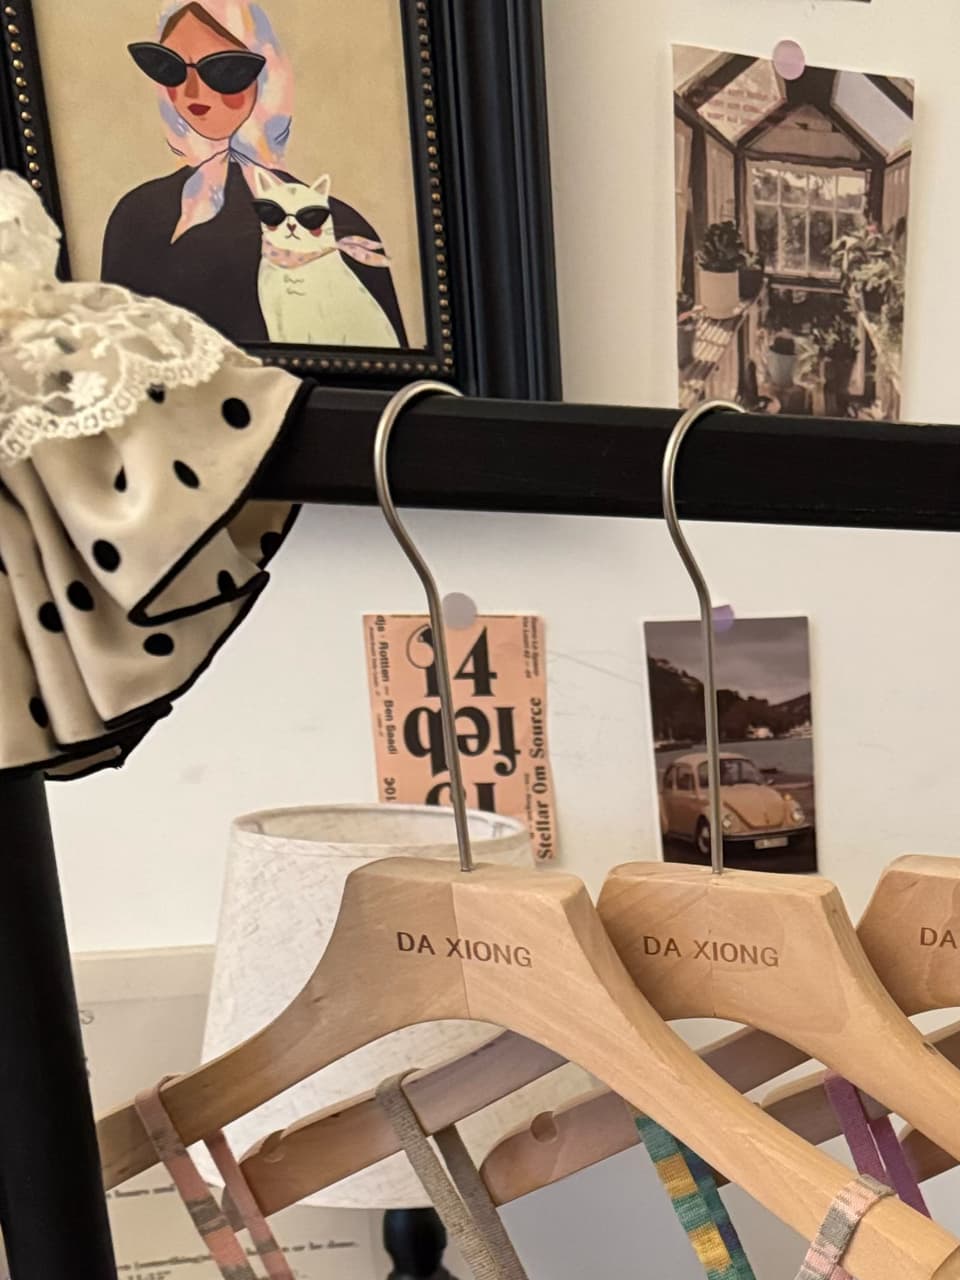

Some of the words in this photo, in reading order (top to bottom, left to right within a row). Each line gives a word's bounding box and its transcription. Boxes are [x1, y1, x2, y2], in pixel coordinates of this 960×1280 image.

[529, 697, 546, 759] Source
[533, 799, 553, 861] Stellar
[397, 931, 435, 956] DA
[446, 936, 533, 968] XIONG
[643, 935, 682, 958] DA
[694, 939, 780, 968] XIONG
[919, 926, 957, 951] DA
